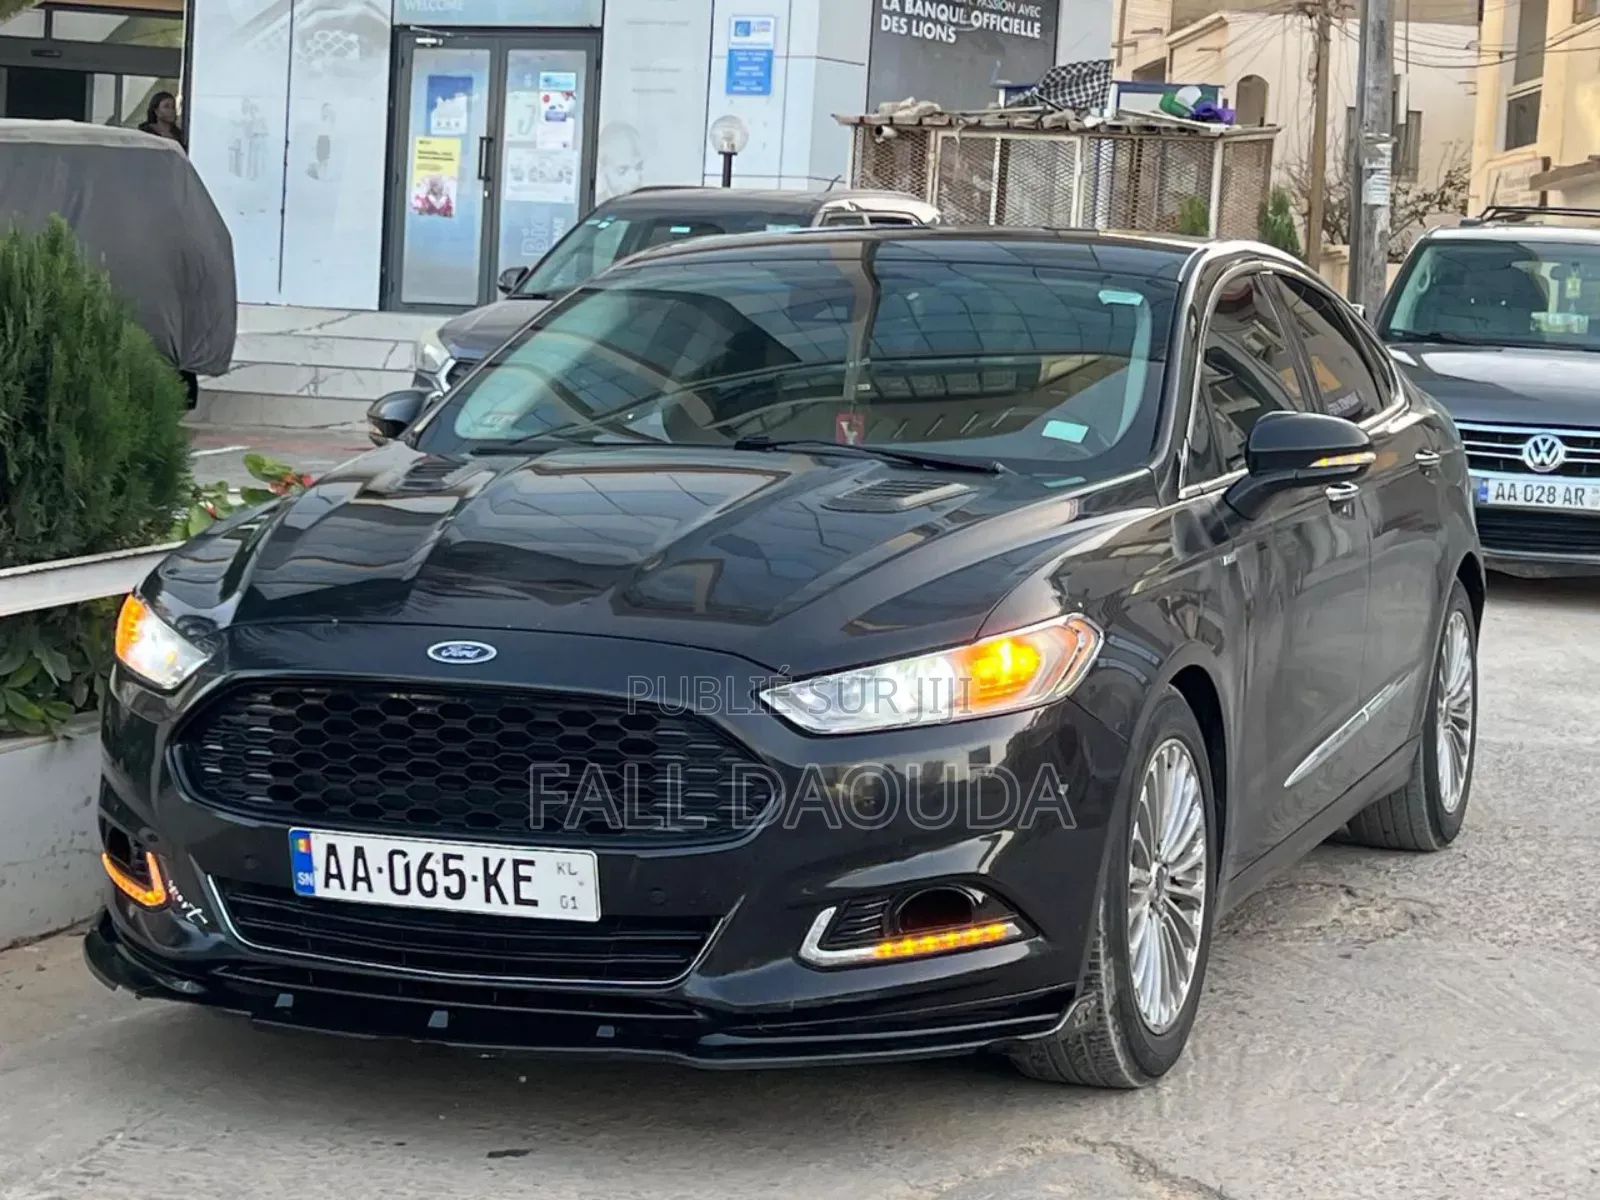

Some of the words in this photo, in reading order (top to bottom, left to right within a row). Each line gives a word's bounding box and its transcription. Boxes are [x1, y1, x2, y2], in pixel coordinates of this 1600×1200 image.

[1017, 4, 1041, 18] AVEC
[881, 14, 908, 35] DES
[912, 18, 957, 44] LIONS
[970, 9, 1041, 39] OFFICIELLE
[1495, 482, 1518, 502] AA
[1523, 484, 1556, 505] 028
[1562, 487, 1586, 507] AR
[297, 871, 313, 885] SN
